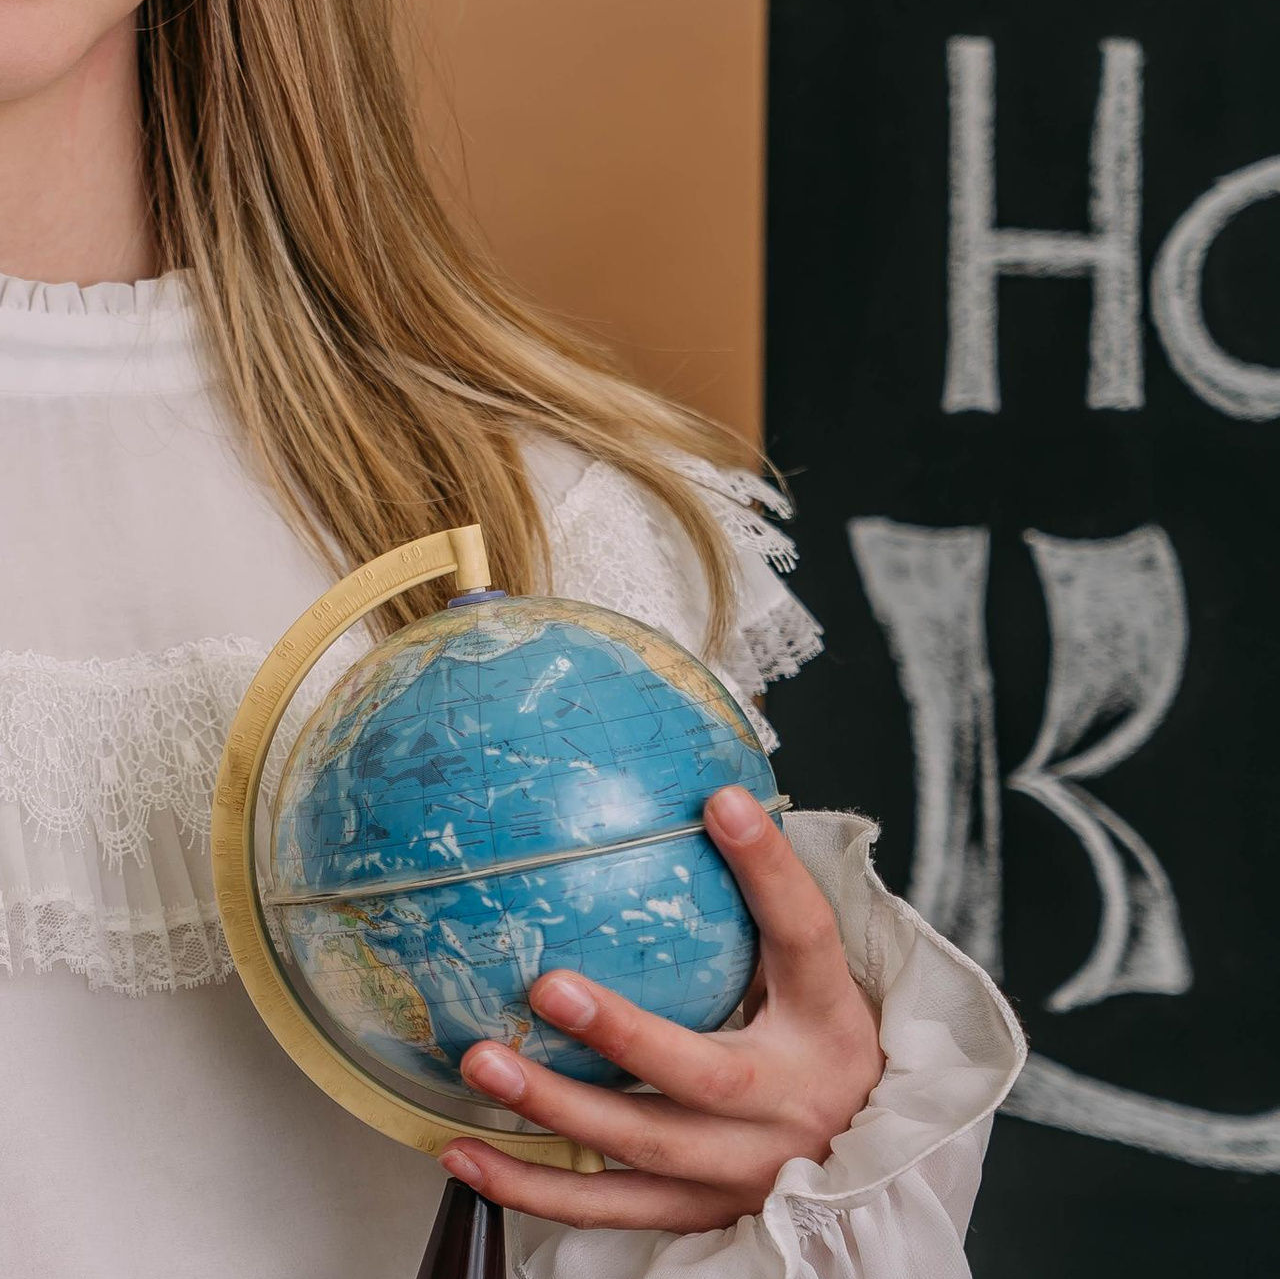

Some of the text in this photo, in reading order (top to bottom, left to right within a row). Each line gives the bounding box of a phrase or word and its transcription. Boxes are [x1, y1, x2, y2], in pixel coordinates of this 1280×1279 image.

[312, 600, 333, 620] 60
[217, 784, 233, 806] 20
[215, 836, 229, 858] 10
